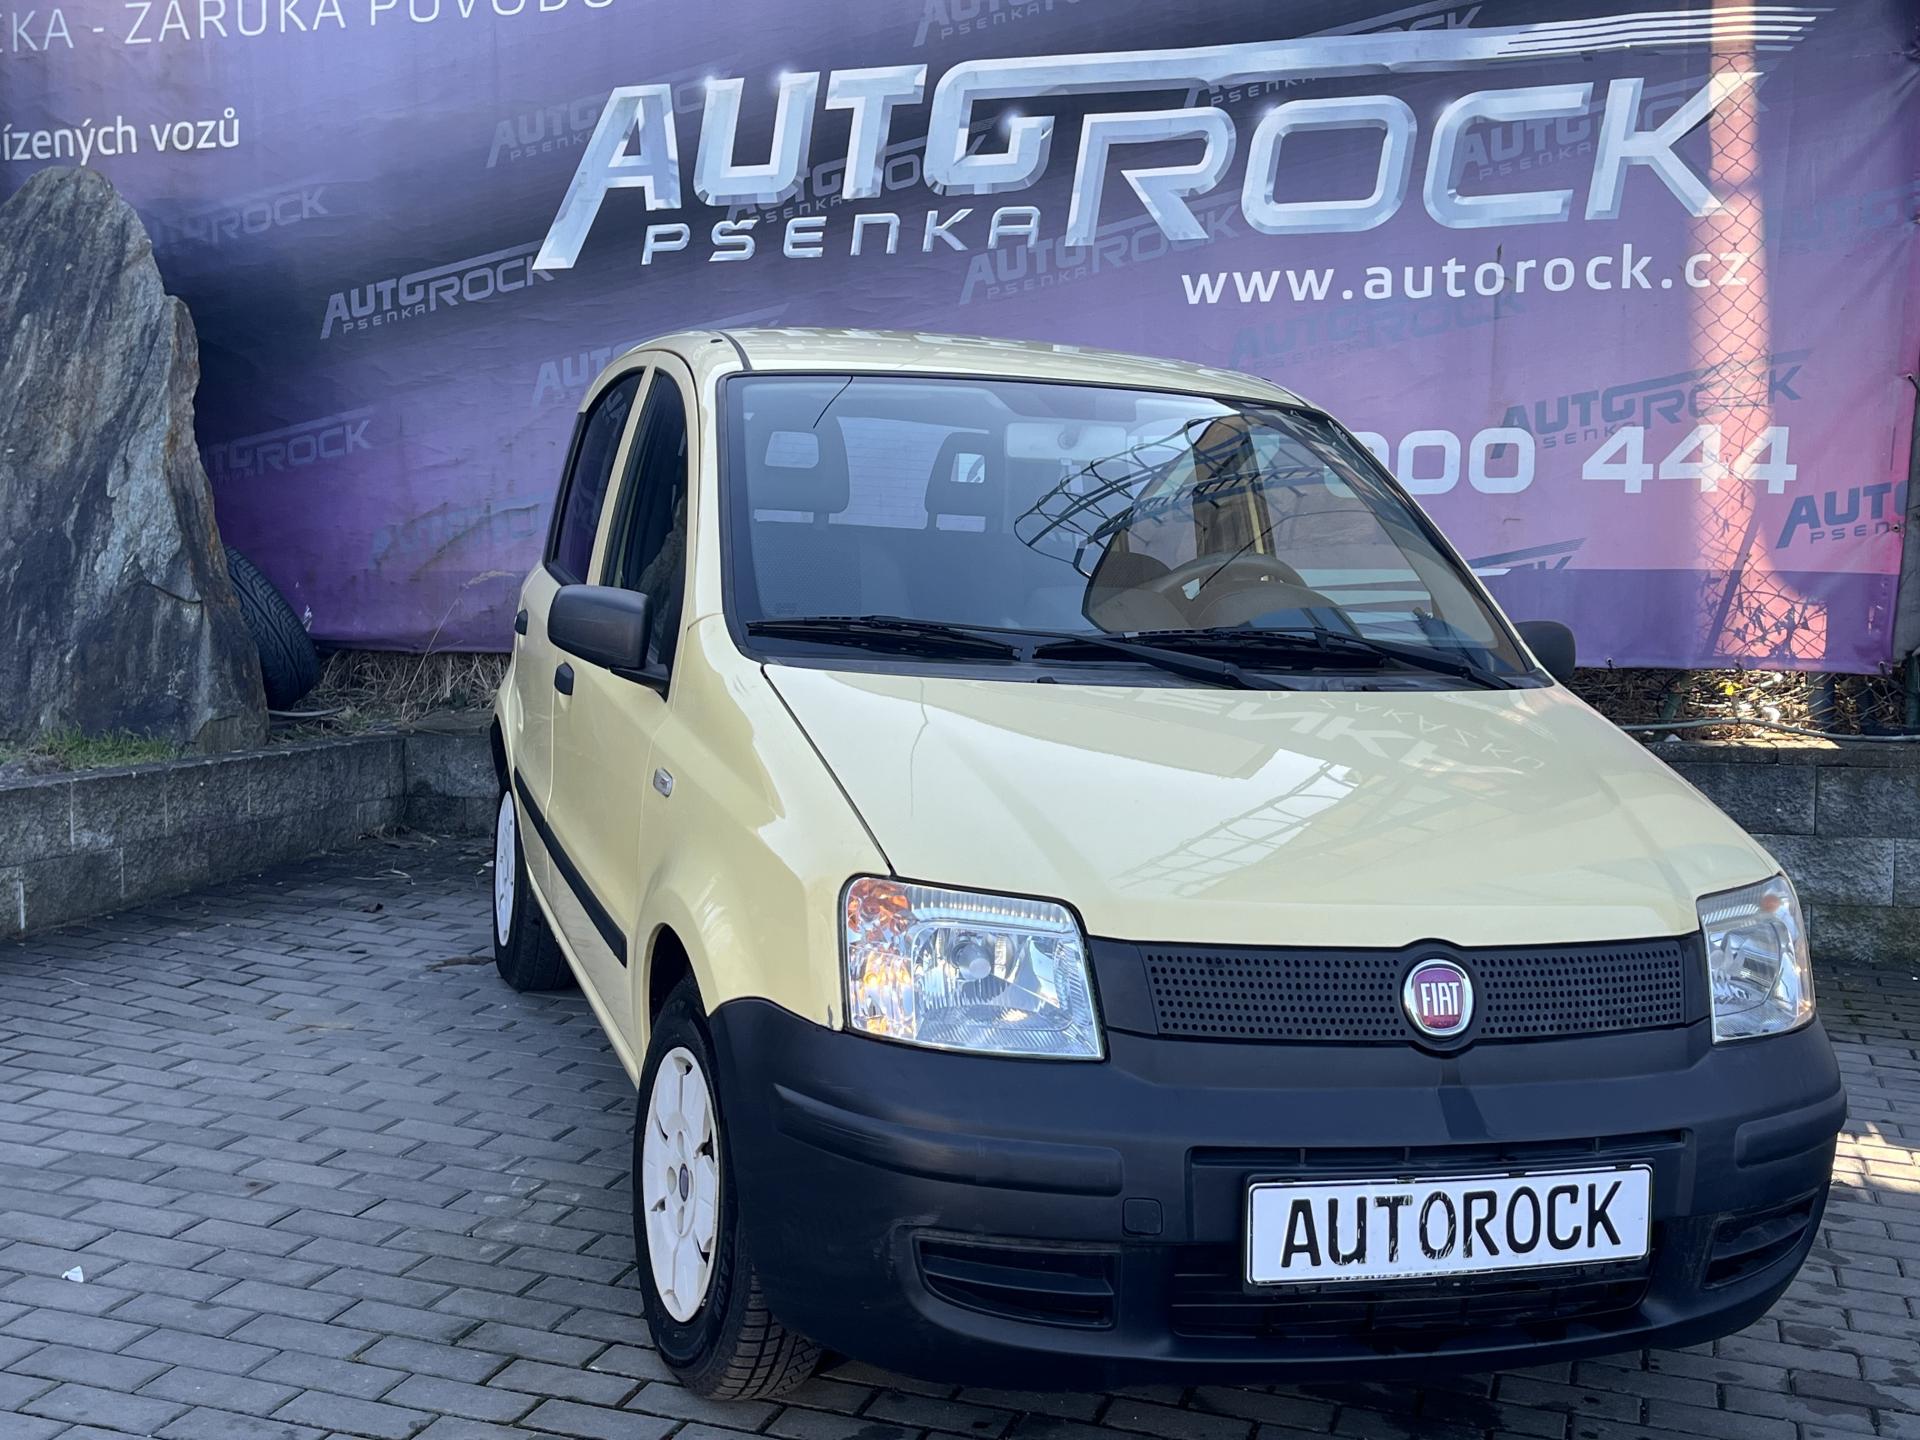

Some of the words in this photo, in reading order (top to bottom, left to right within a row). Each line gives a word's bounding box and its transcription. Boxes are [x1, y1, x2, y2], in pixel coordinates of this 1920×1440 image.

[0, 9, 74, 52] KA
[150, 108, 240, 152] vozů
[1181, 243, 1750, 305] www.autorock.cz
[343, 303, 427, 334] PSENKA
[1581, 425, 1798, 494] 444
[1420, 981, 1460, 1017] FIAT
[1280, 1180, 1623, 1268] AUTOROCK
